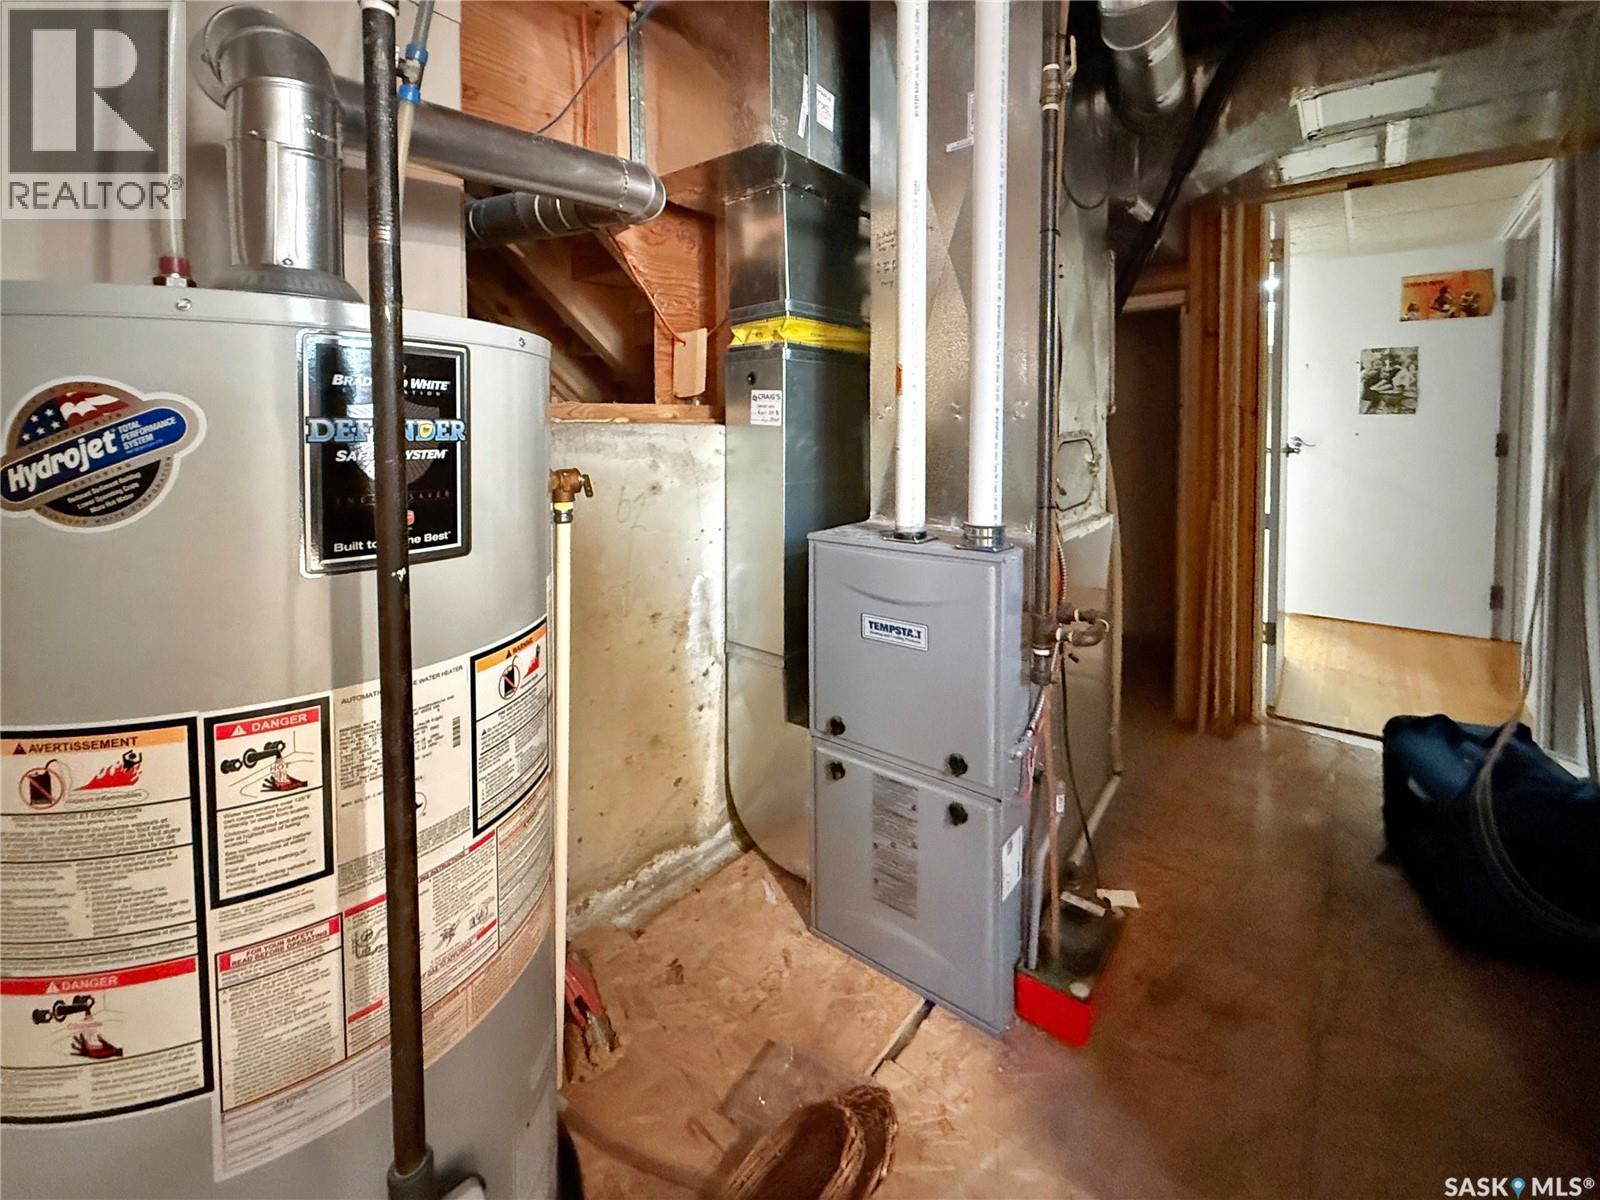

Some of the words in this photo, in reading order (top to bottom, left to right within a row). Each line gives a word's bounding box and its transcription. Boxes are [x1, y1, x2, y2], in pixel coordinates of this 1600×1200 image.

[410, 378, 448, 391] WHITE
[118, 420, 142, 433] TOTAL
[120, 416, 177, 442] PERFORMANCE
[306, 417, 467, 443] DEFNDER
[122, 433, 154, 450] SYSTEM
[405, 449, 447, 460] YSTEM
[333, 541, 364, 553] Built
[424, 531, 449, 541] Best
[418, 672, 440, 684] WATER
[441, 664, 463, 677] HEATER
[251, 713, 308, 732] DANGER
[28, 736, 139, 754] AVERTISSEMENT
[61, 975, 119, 992] DANGER
